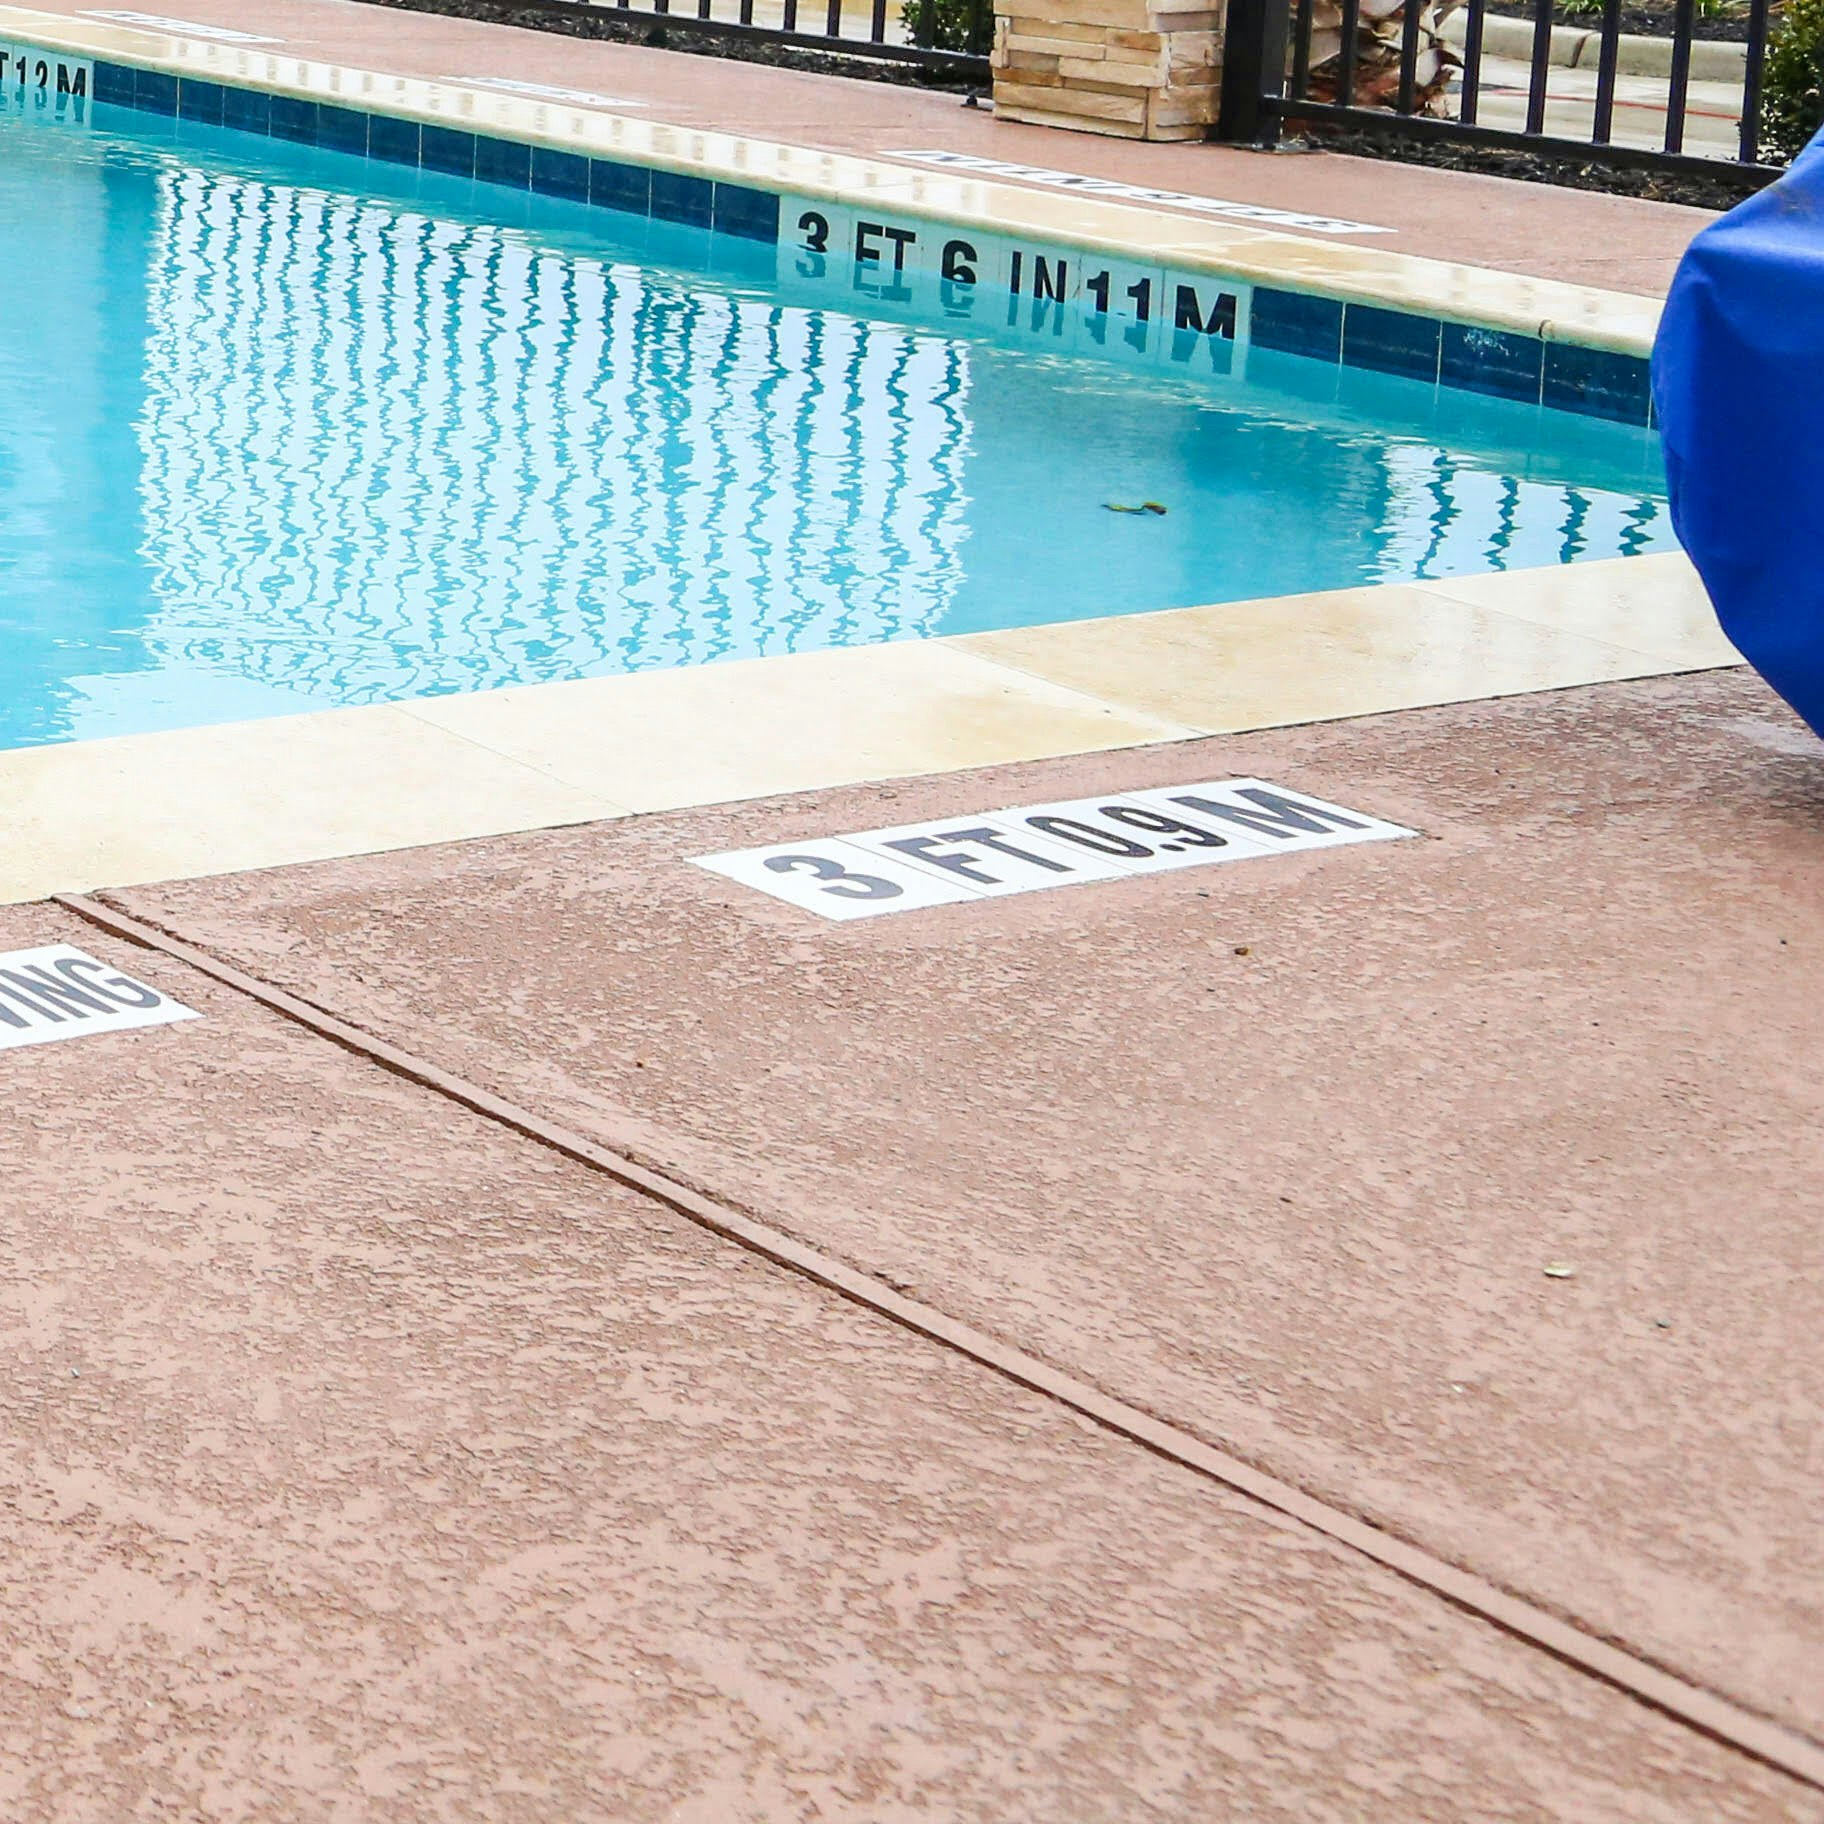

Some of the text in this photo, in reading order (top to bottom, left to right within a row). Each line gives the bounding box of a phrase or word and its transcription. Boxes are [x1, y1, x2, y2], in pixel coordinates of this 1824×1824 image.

[56, 62, 87, 98] M
[797, 211, 829, 254] 3
[855, 221, 916, 271] FT
[941, 239, 978, 285] 6
[1010, 250, 1068, 304] IN
[1175, 283, 1238, 340] M
[762, 854, 905, 901] 3
[880, 826, 1077, 885] FT
[1167, 787, 1373, 840] M
